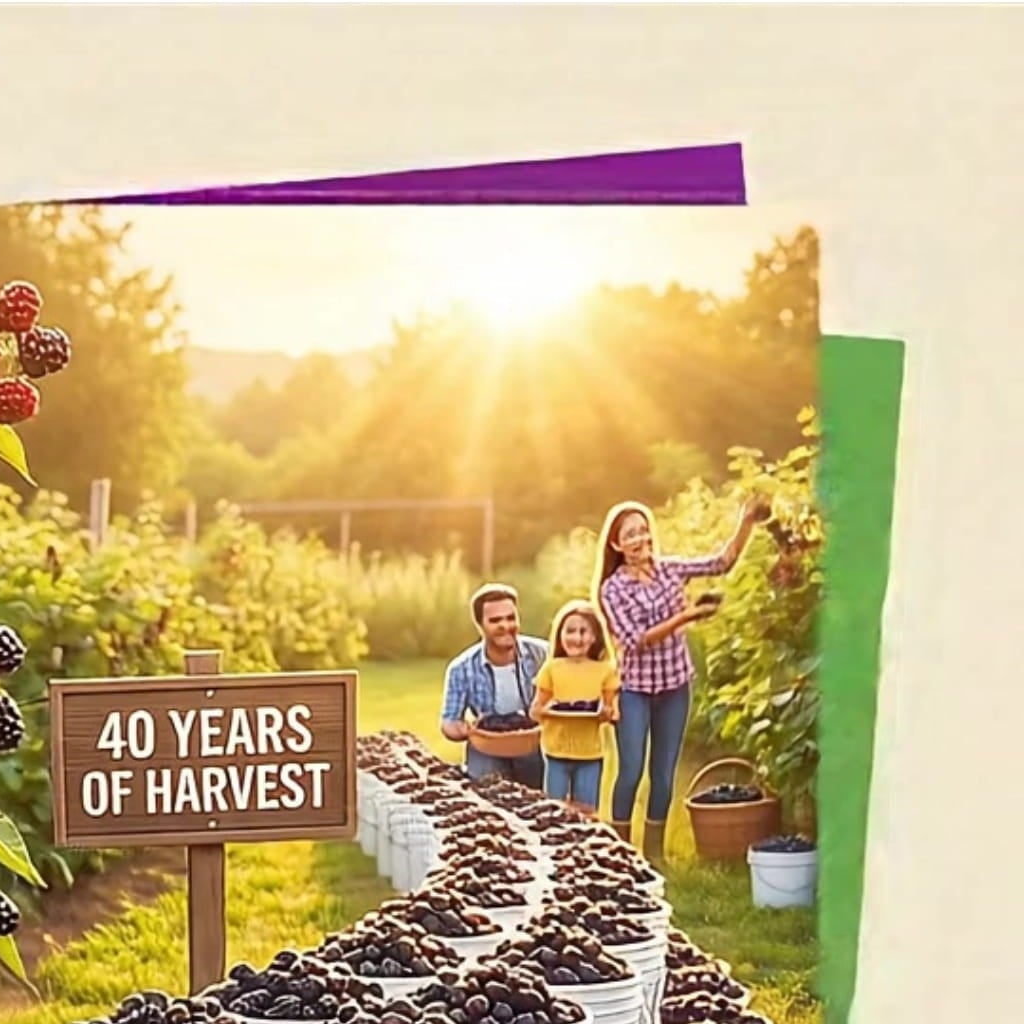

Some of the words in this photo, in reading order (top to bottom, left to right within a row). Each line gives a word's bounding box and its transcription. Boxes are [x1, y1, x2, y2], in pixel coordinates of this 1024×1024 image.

[96, 709, 155, 760] 40
[168, 704, 314, 759] YEARS
[81, 769, 134, 817] OF
[145, 762, 332, 815] HARVEST
